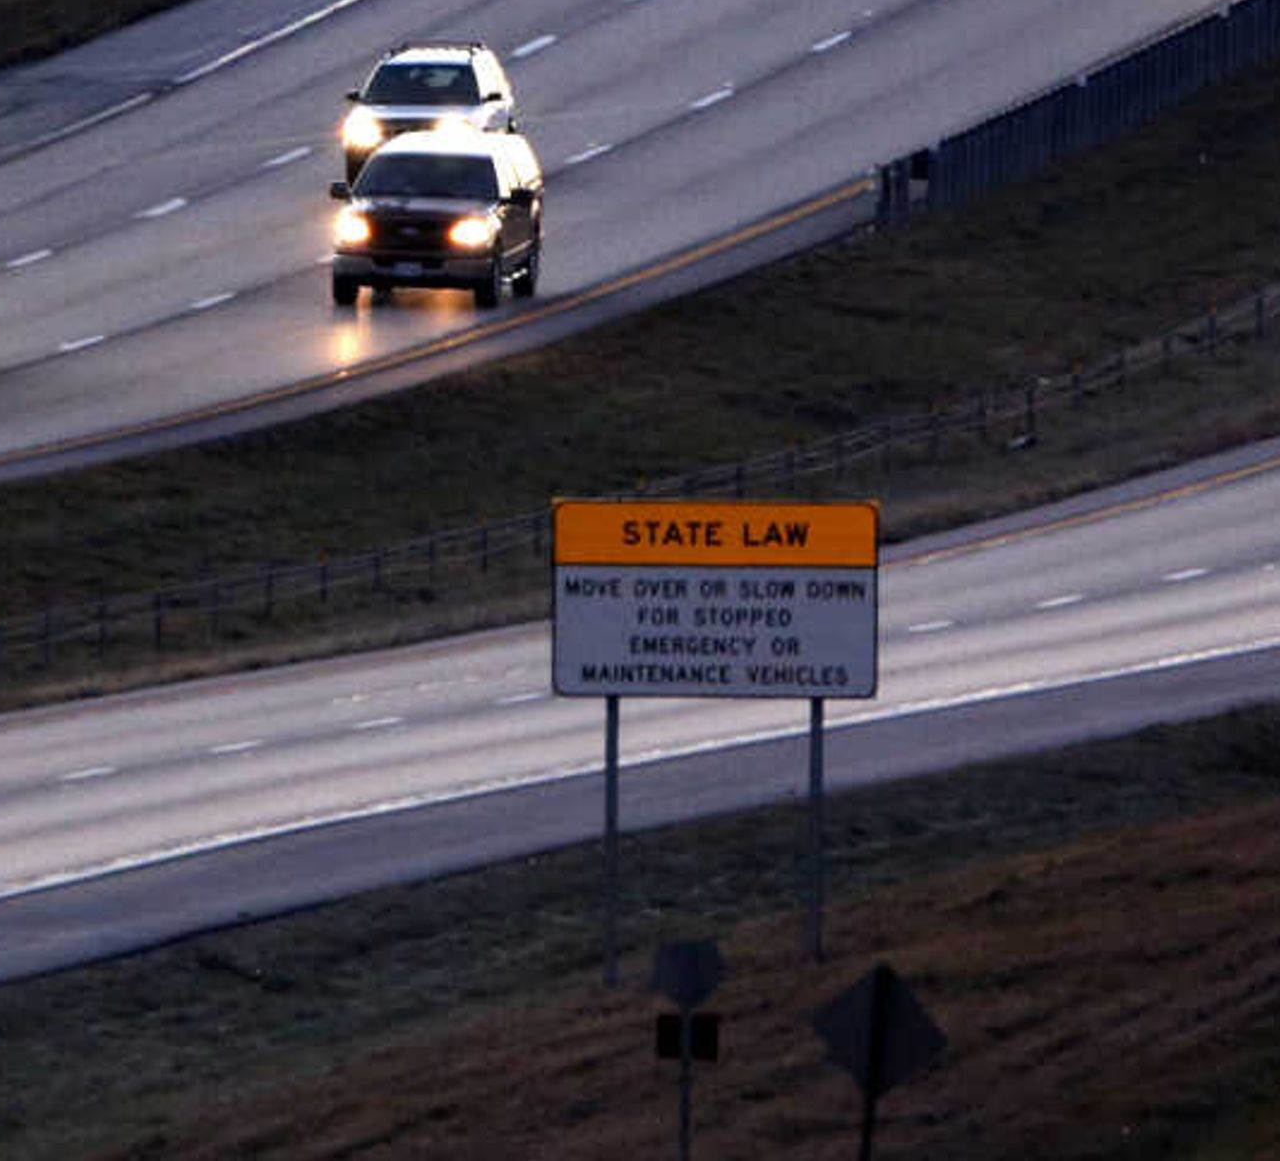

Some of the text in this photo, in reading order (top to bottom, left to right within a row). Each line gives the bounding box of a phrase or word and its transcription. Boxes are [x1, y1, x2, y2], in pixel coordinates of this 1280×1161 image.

[622, 520, 810, 547] STATE LAW
[565, 578, 866, 600] MOVE OVER OR SLOW DOWN
[637, 608, 792, 627] FOR STOPPED
[629, 637, 800, 656] EMERGENCY OR
[582, 664, 849, 687] MAINTENANCE VEHICLES
